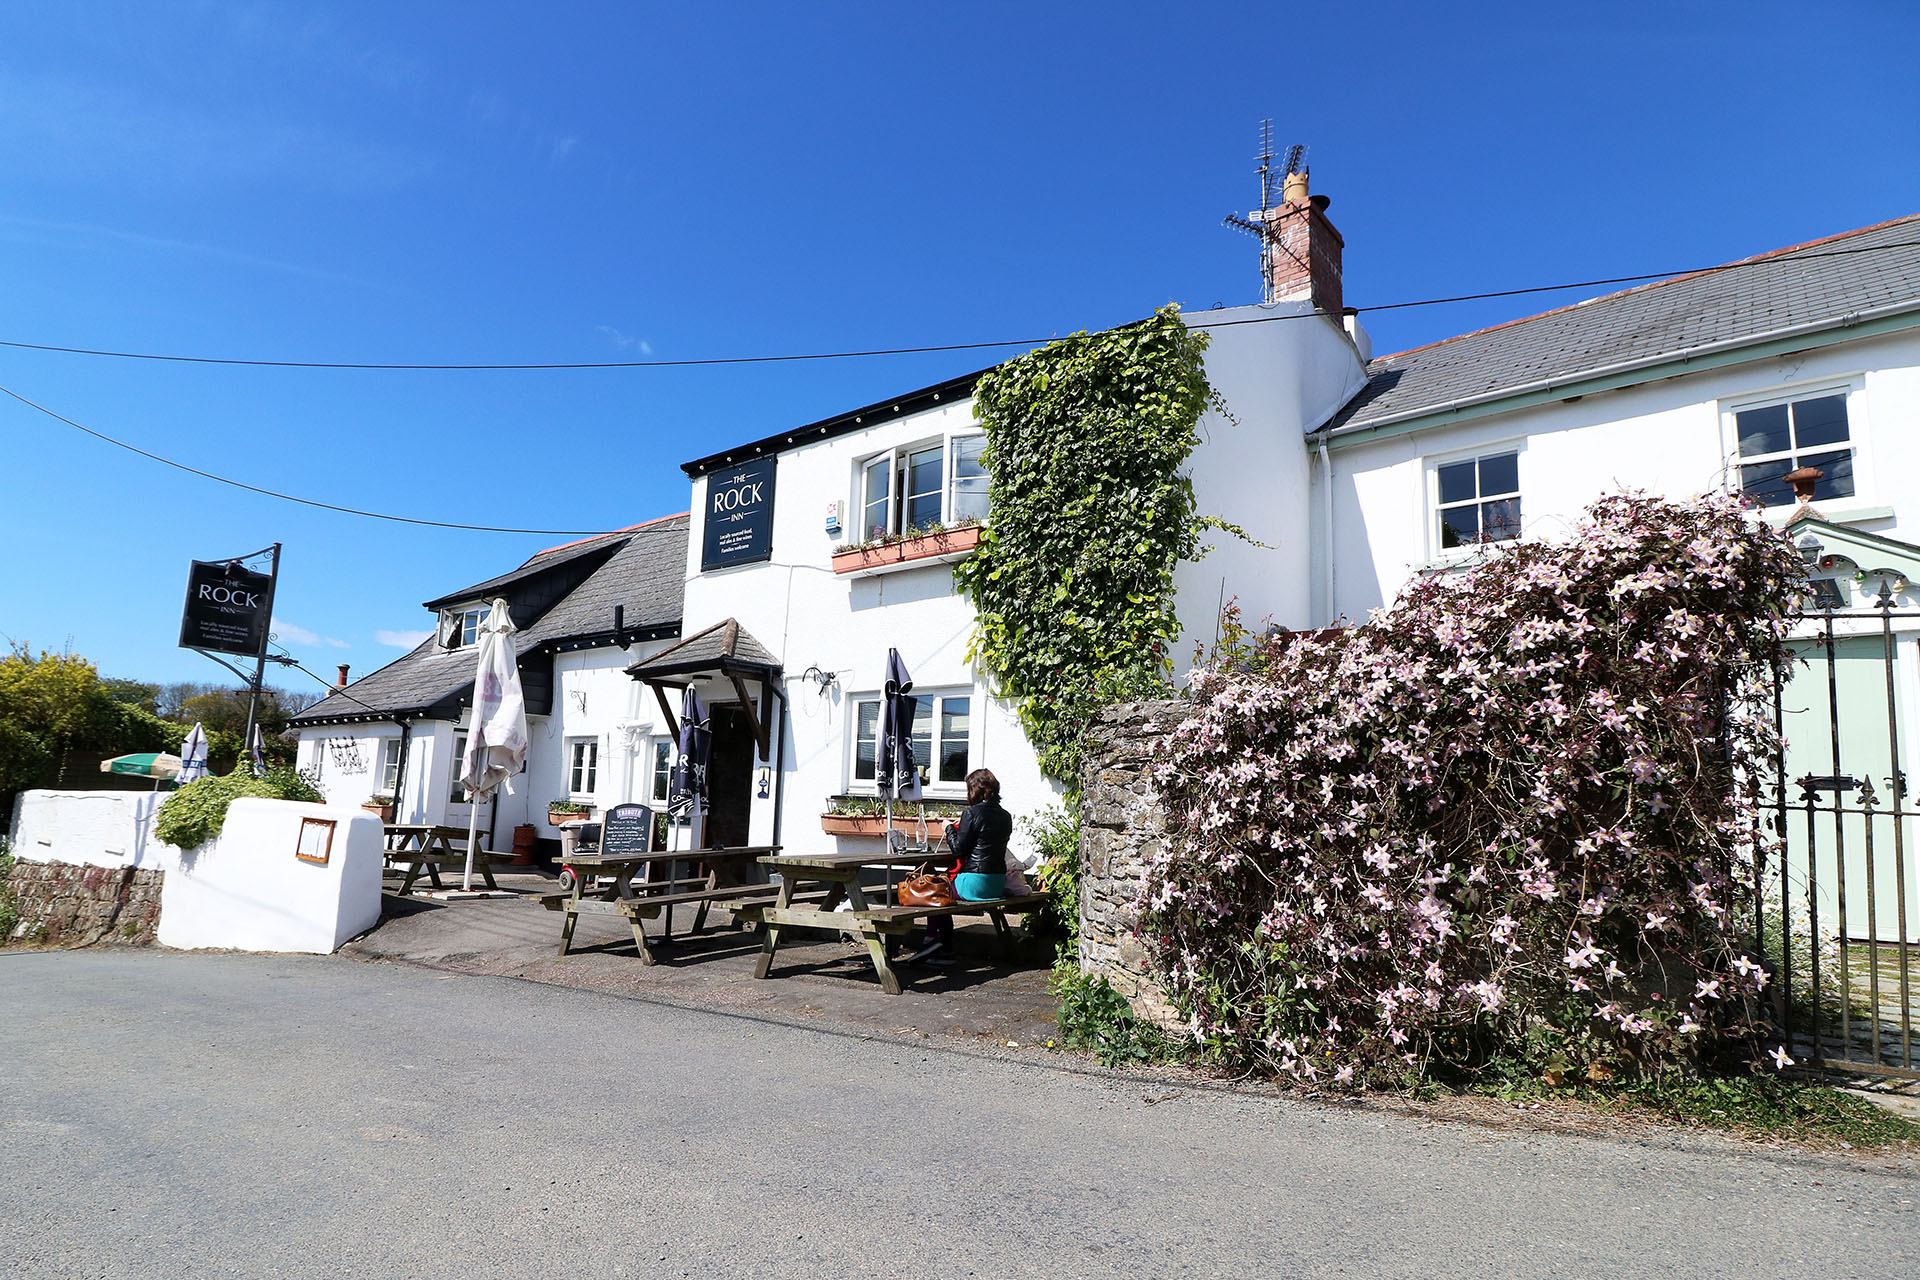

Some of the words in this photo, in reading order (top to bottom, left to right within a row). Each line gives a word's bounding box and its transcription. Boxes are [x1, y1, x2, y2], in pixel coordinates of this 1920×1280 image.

[733, 474, 746, 484] THE
[714, 481, 763, 513] ROCK
[731, 512, 744, 522] INN
[225, 579, 240, 588] THE
[199, 584, 259, 608] ROCK
[220, 606, 236, 614] INN
